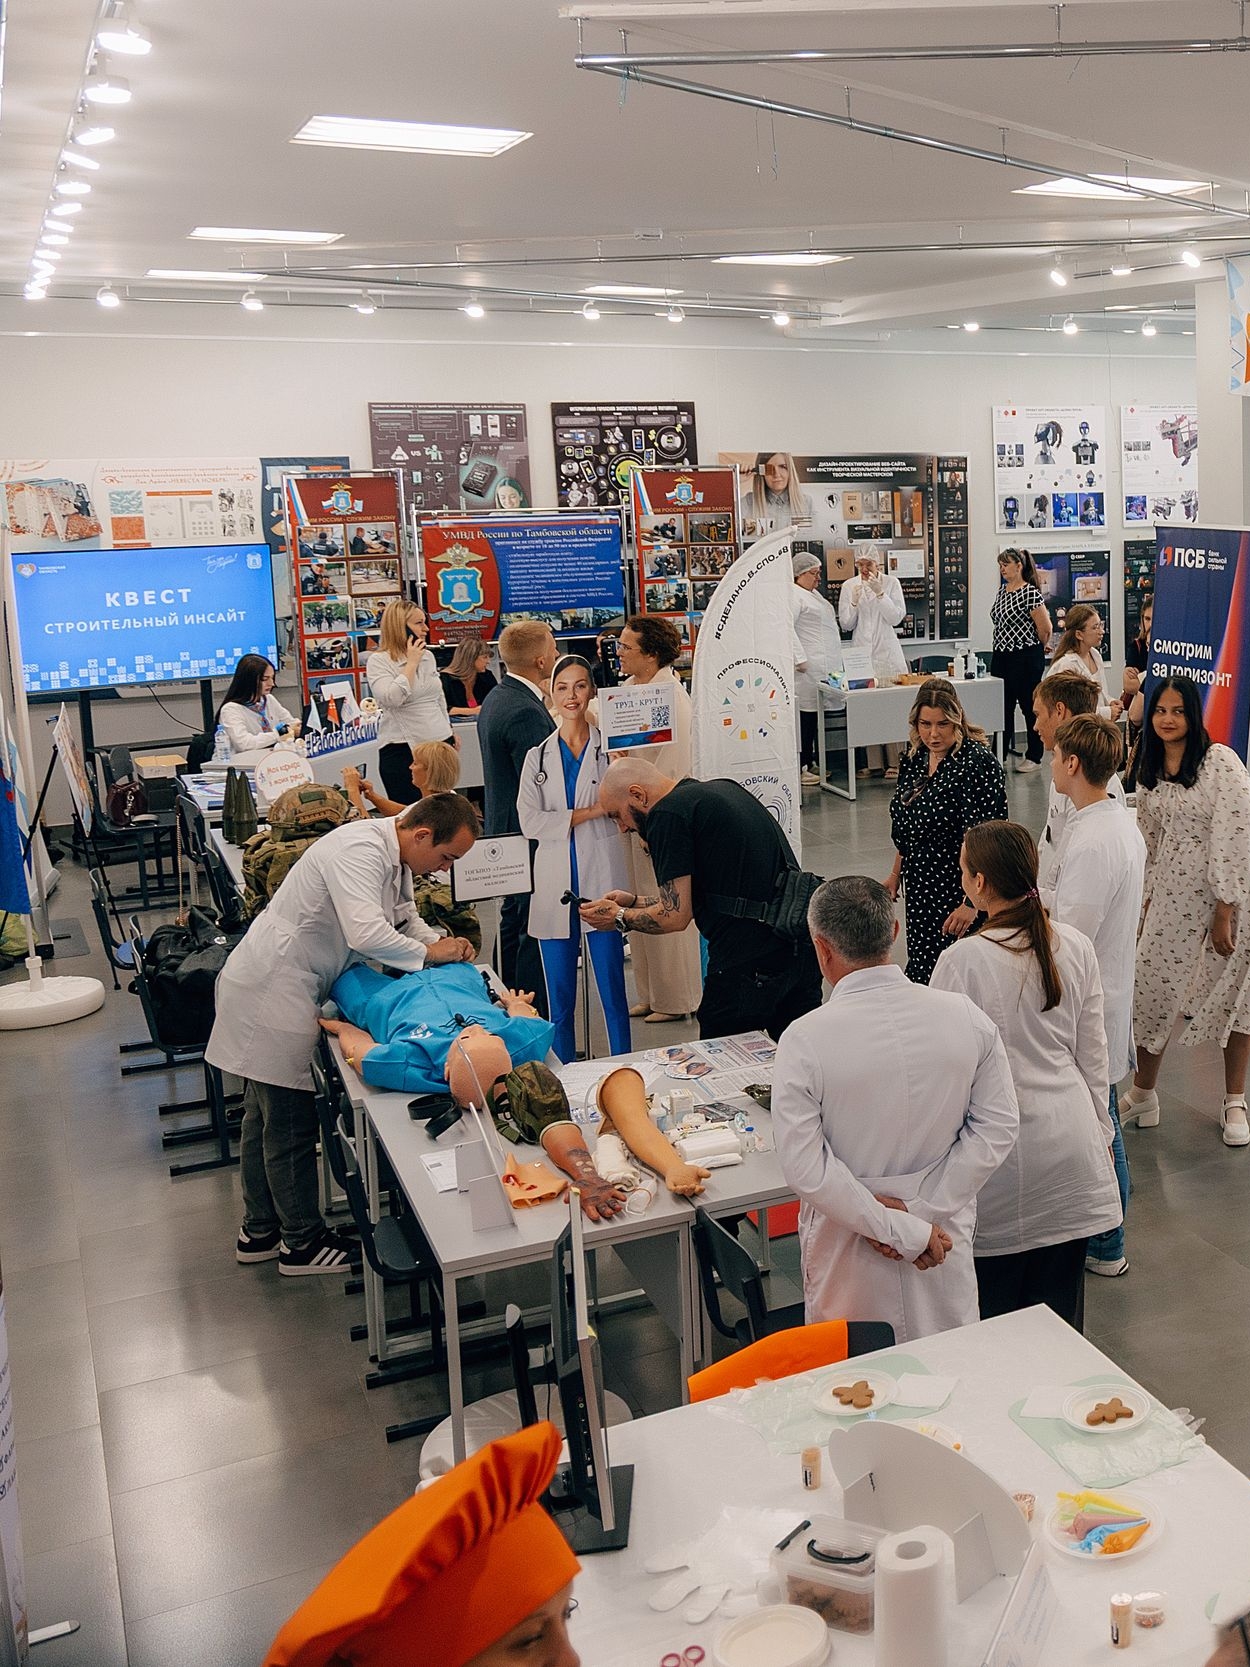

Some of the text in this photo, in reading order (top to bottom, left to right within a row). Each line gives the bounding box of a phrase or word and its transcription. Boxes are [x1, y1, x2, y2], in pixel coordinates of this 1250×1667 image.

[442, 526, 613, 540] УМВД России по Тамбовской области
[1174, 547, 1220, 569] ПСБ банк
[1208, 556, 1227, 565] сильной
[1207, 563, 1225, 571] страны
[105, 588, 192, 608] КВЕСТ
[44, 608, 247, 634] СТРОИТЕЛЬНЫЙ ИНСАЙТ
[1153, 638, 1212, 660] смотрим
[1152, 663, 1232, 687] за горизонт
[614, 700, 634, 709] ТРУД
[640, 698, 658, 706] КРУТ
[740, 775, 779, 788] БОВСКИЙ
[464, 867, 491, 876] ТОГБПОУ
